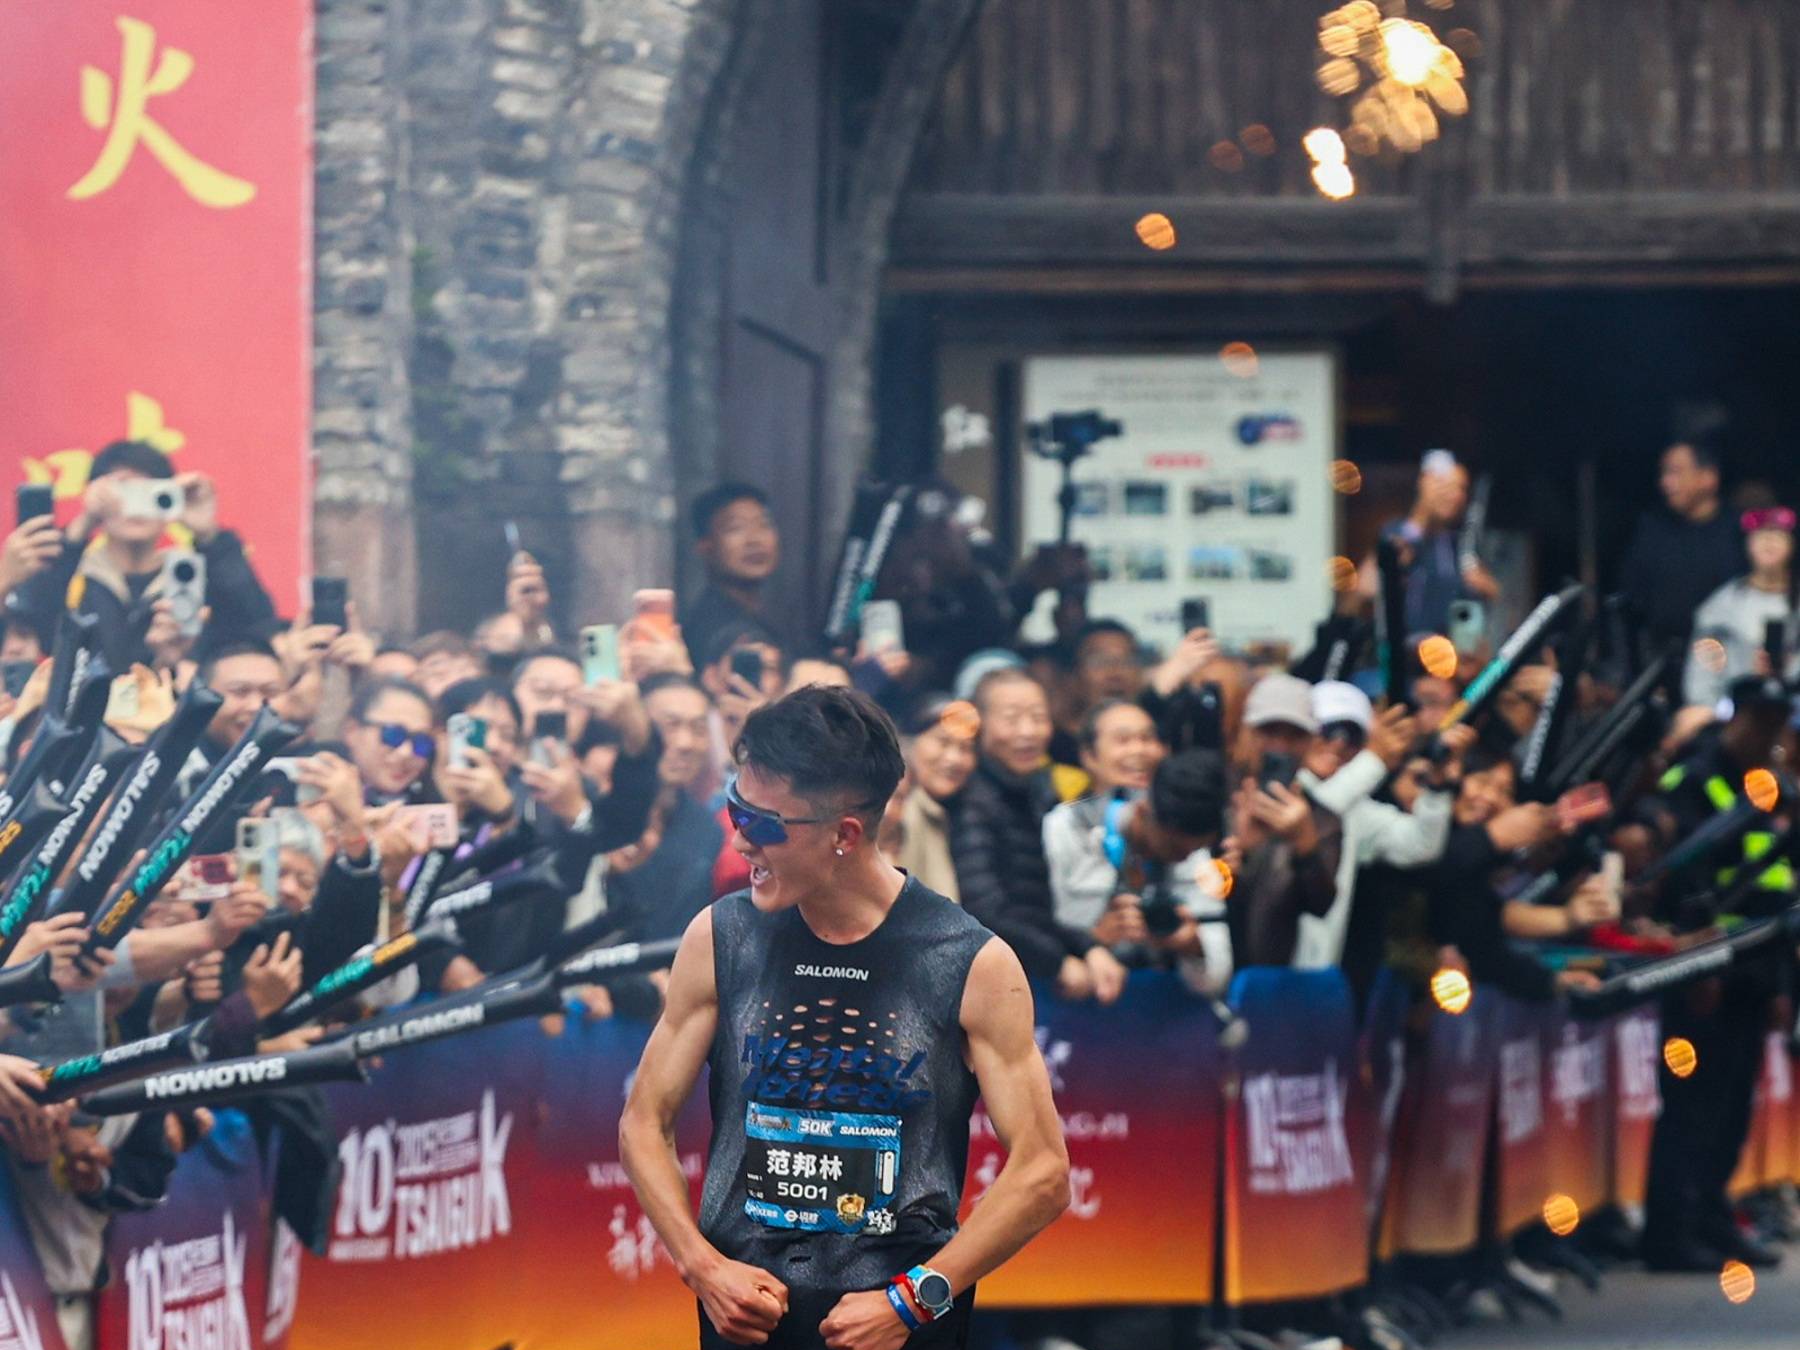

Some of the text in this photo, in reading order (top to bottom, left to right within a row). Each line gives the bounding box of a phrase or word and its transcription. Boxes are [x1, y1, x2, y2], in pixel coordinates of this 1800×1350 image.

[66, 15, 257, 209] 火
[181, 741, 261, 833] SALOMON
[79, 750, 161, 882] SALOMON
[795, 964, 869, 981] SALOMON
[145, 1056, 287, 1100] SALOMON
[799, 1118, 835, 1136] 50K
[840, 1126, 897, 1137] SALOMON
[767, 1149, 843, 1181] 范邦林
[777, 1182, 828, 1201] 5001
